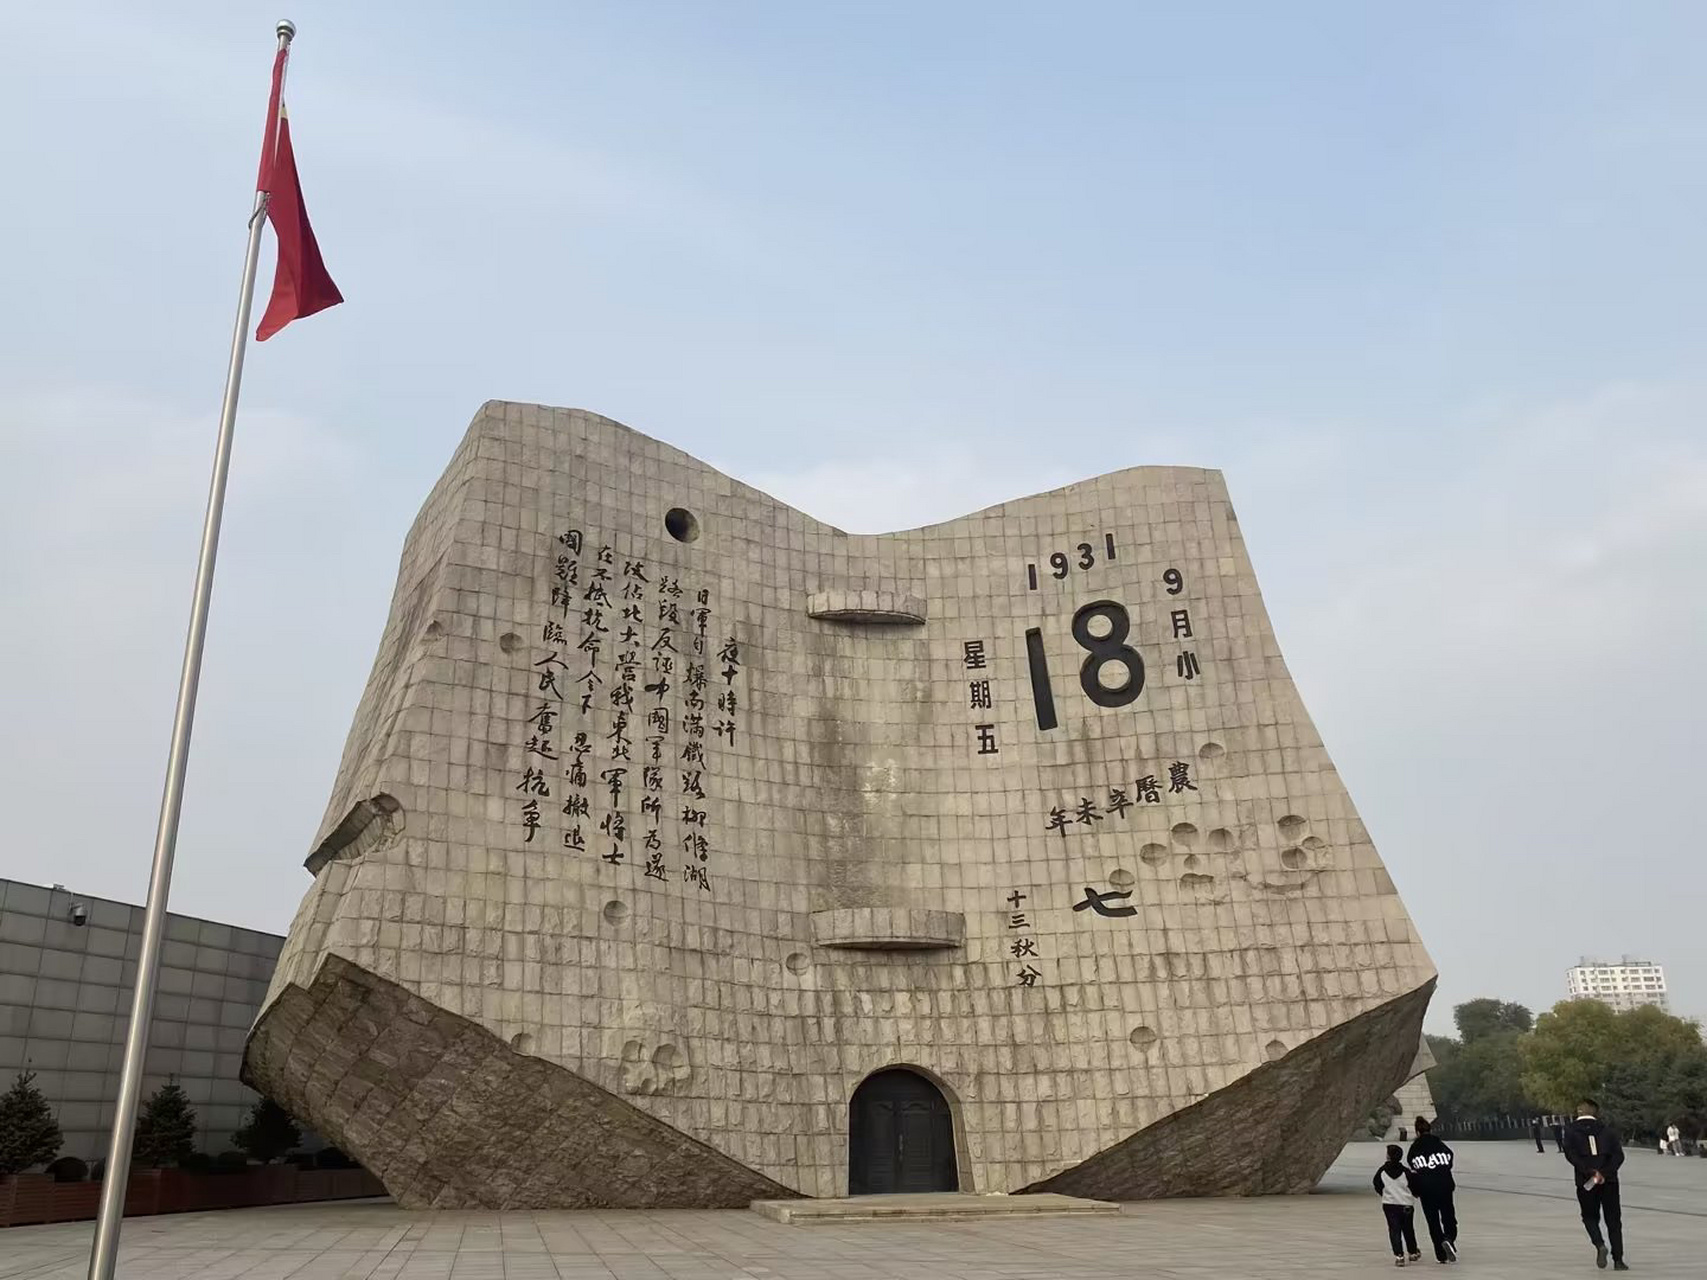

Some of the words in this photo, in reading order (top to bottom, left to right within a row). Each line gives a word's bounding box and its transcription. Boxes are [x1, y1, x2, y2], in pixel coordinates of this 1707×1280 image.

[1028, 533, 1116, 590] 1931
[713, 637, 741, 747] 夜十時許
[964, 640, 998, 754] 星期五
[1025, 600, 1145, 731] 18
[1072, 887, 1138, 917] 七
